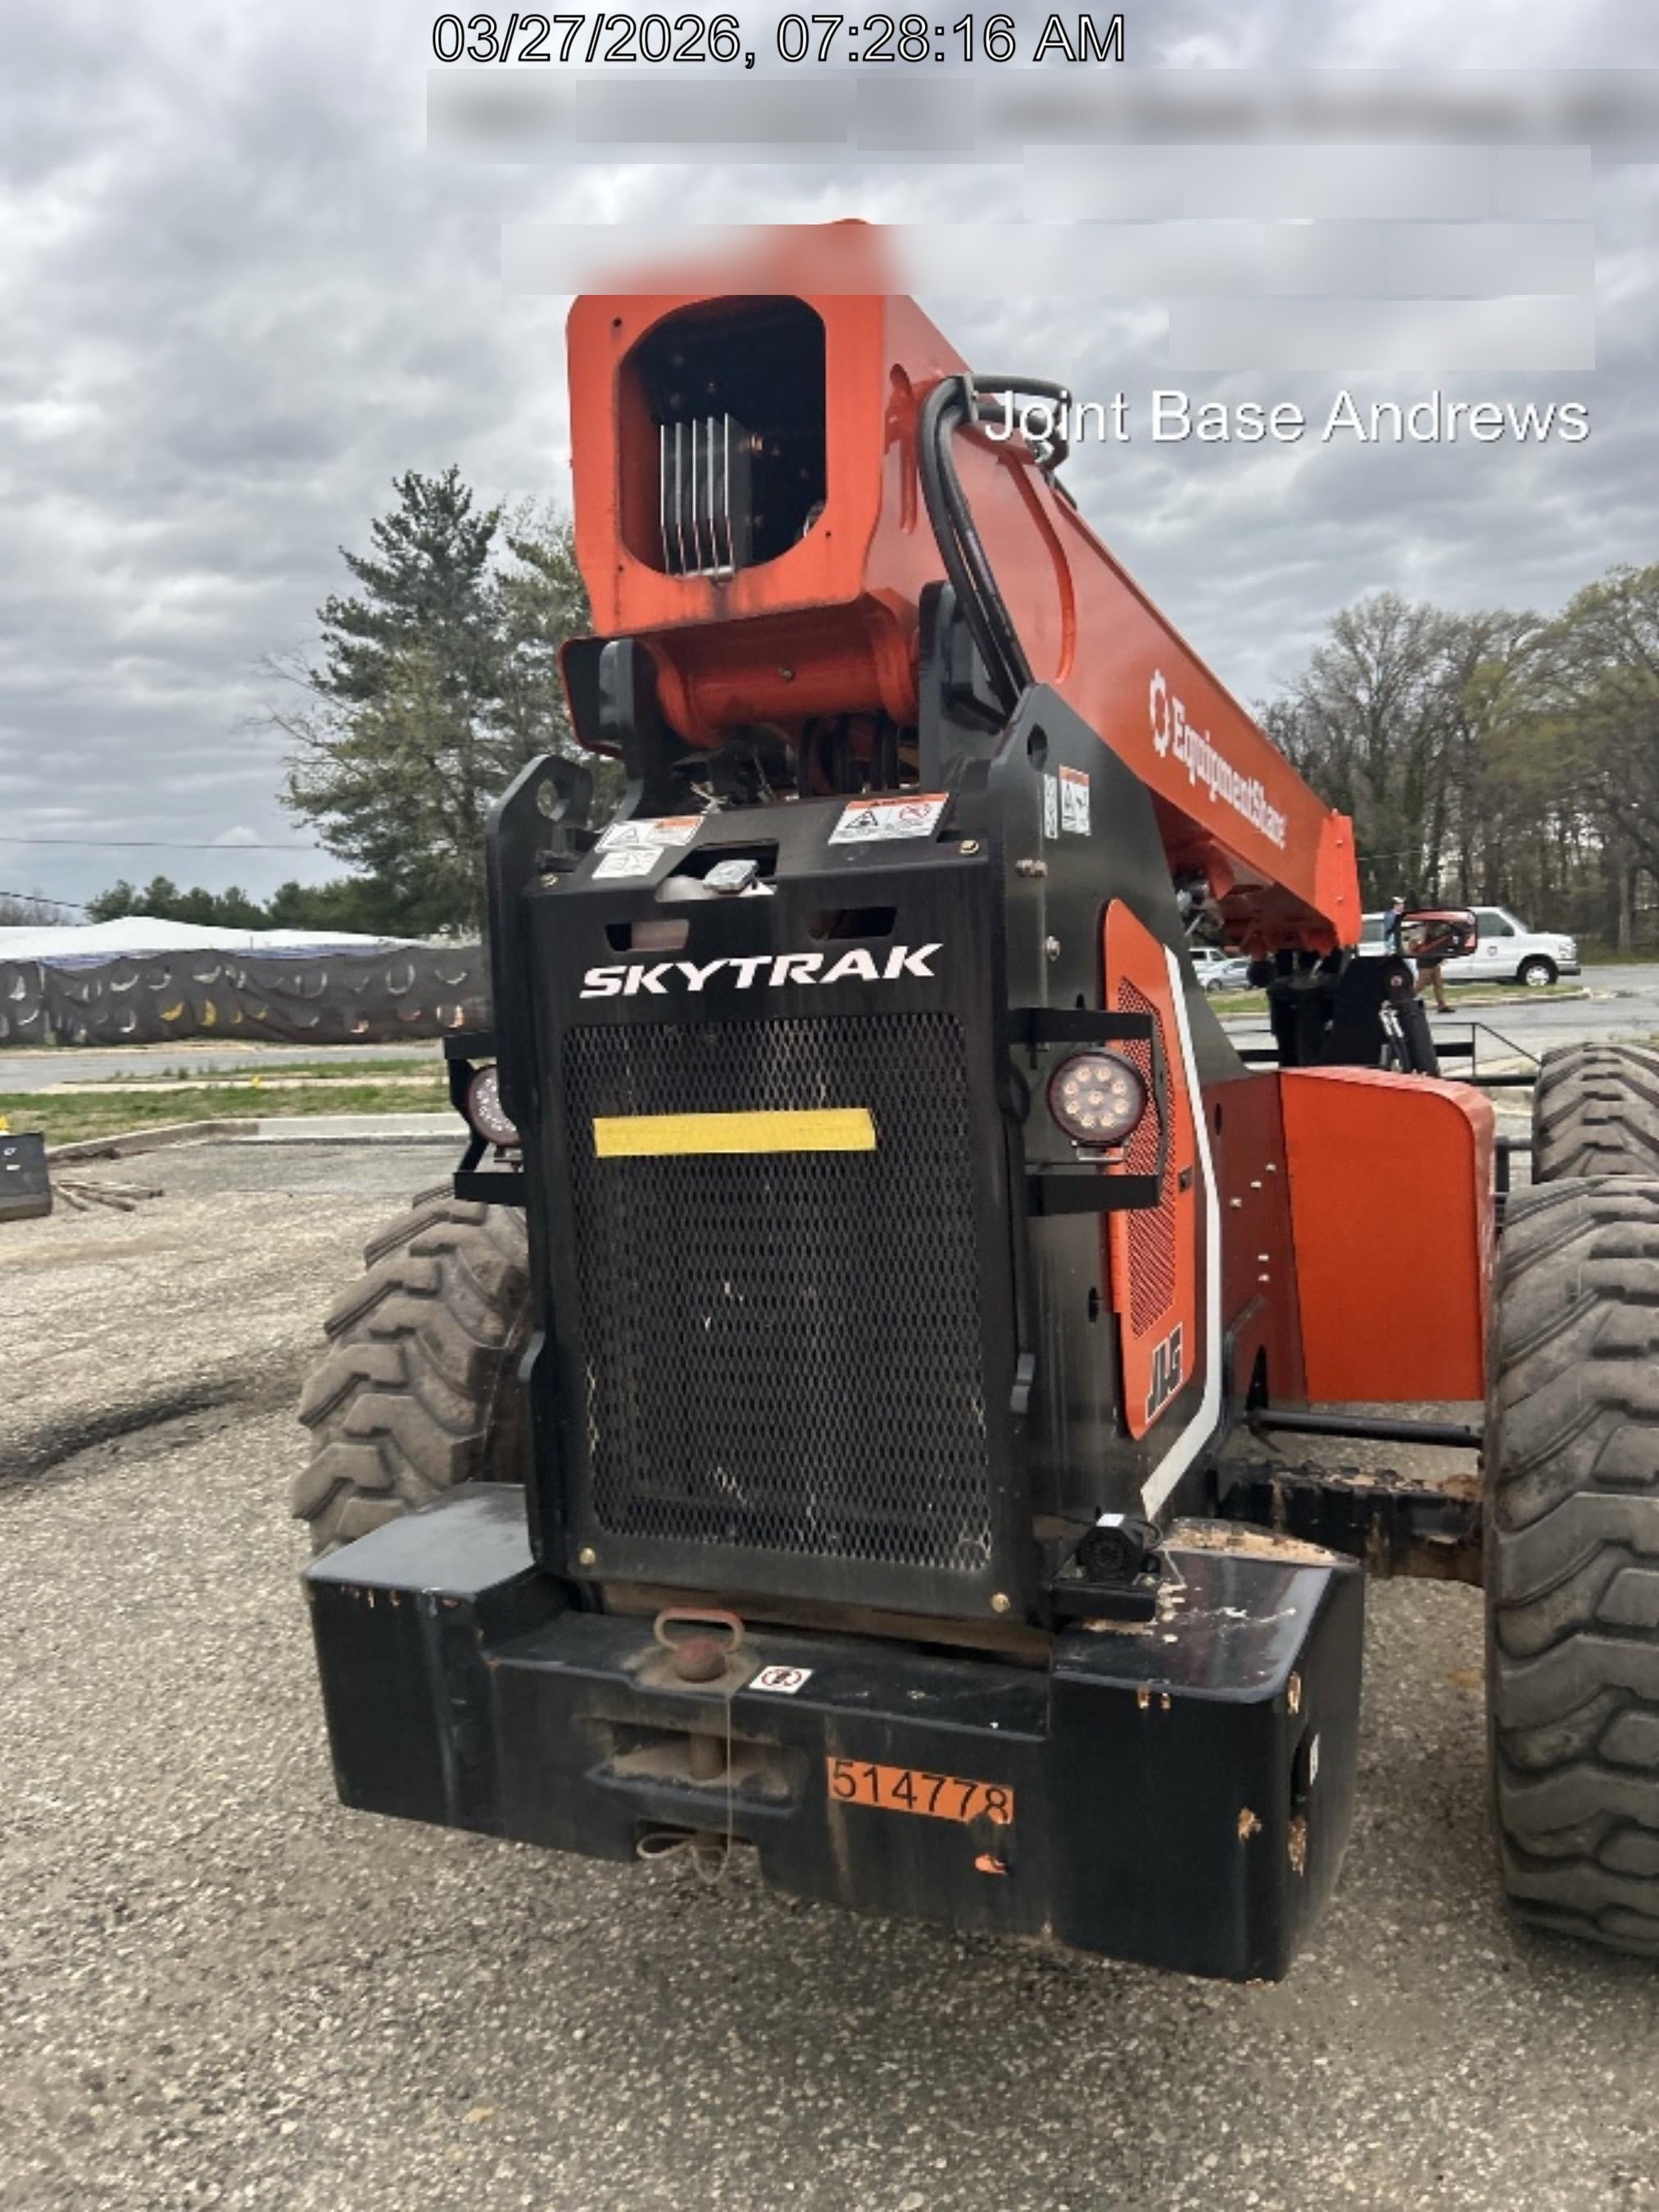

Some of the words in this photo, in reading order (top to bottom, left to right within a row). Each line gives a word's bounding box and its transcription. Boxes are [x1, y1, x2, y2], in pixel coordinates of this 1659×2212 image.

[579, 943, 944, 998] SKYTRAK
[1145, 1322, 1183, 1425] JLG
[832, 1761, 1010, 1824] 514778
